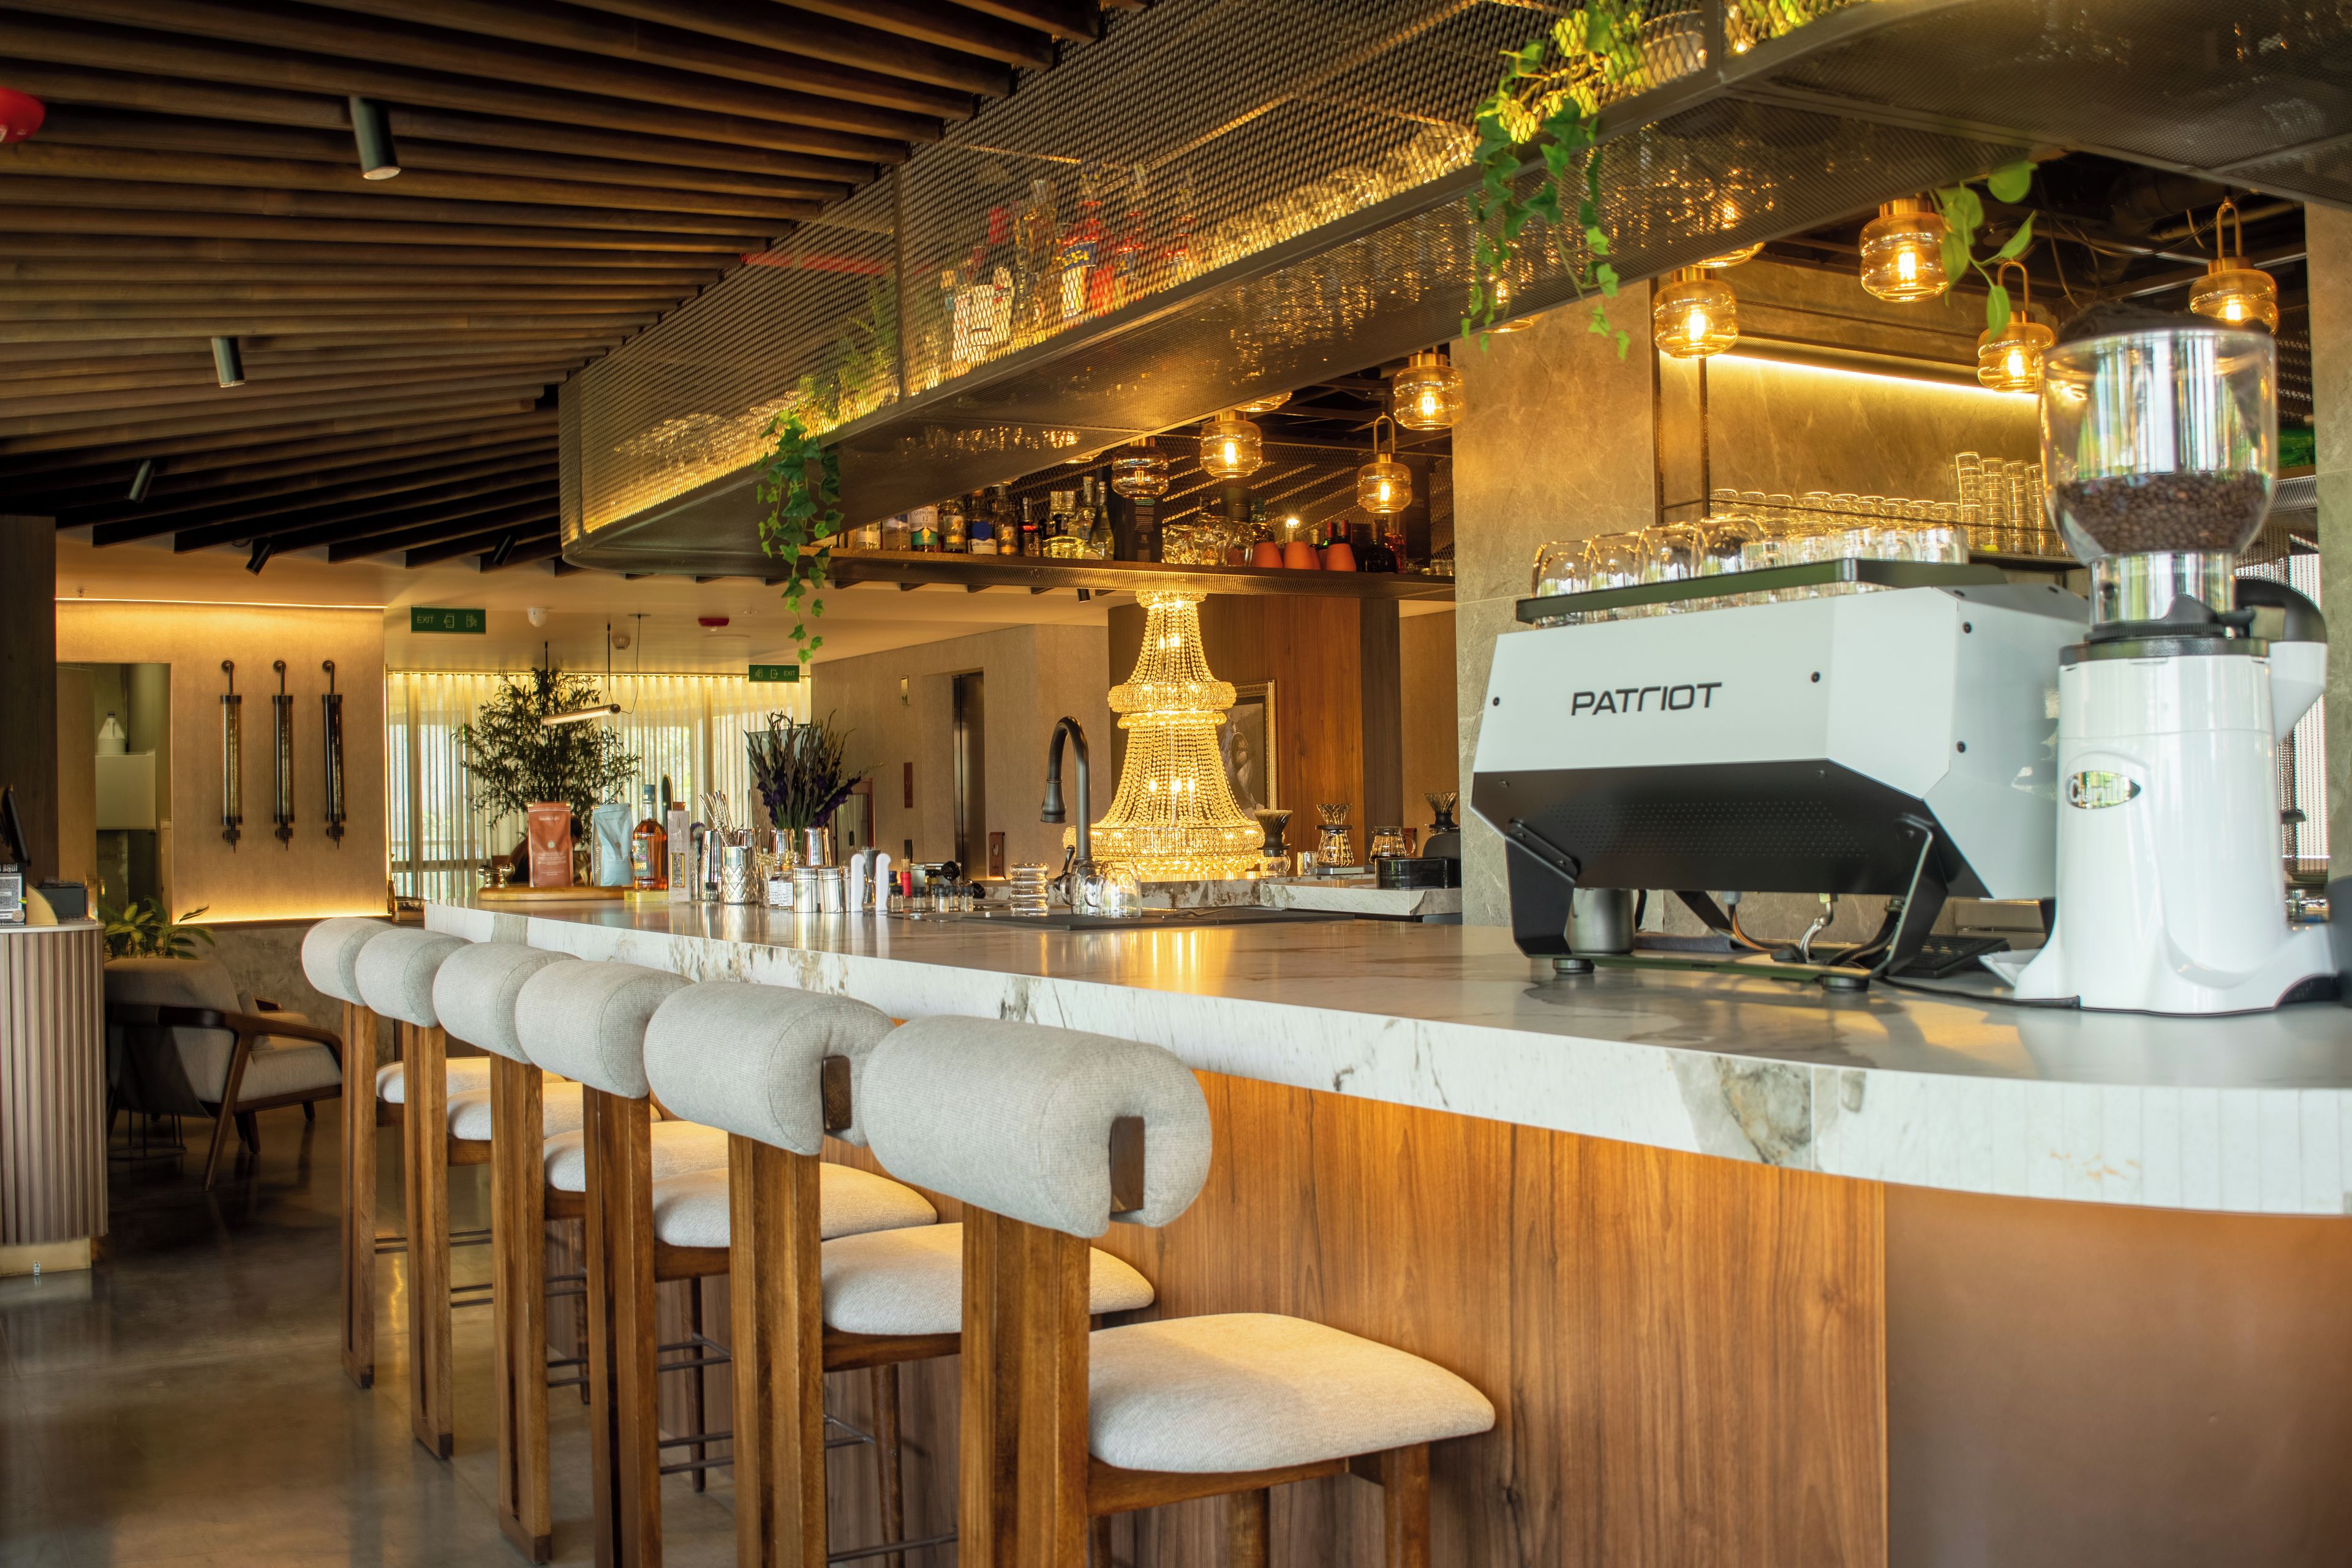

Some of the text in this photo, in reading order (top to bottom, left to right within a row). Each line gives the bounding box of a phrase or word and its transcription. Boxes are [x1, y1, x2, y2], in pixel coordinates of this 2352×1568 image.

[417, 615, 434, 624] EXIT
[1571, 682, 1722, 715] PATRIOT
[2069, 775, 2122, 803] Cunill
